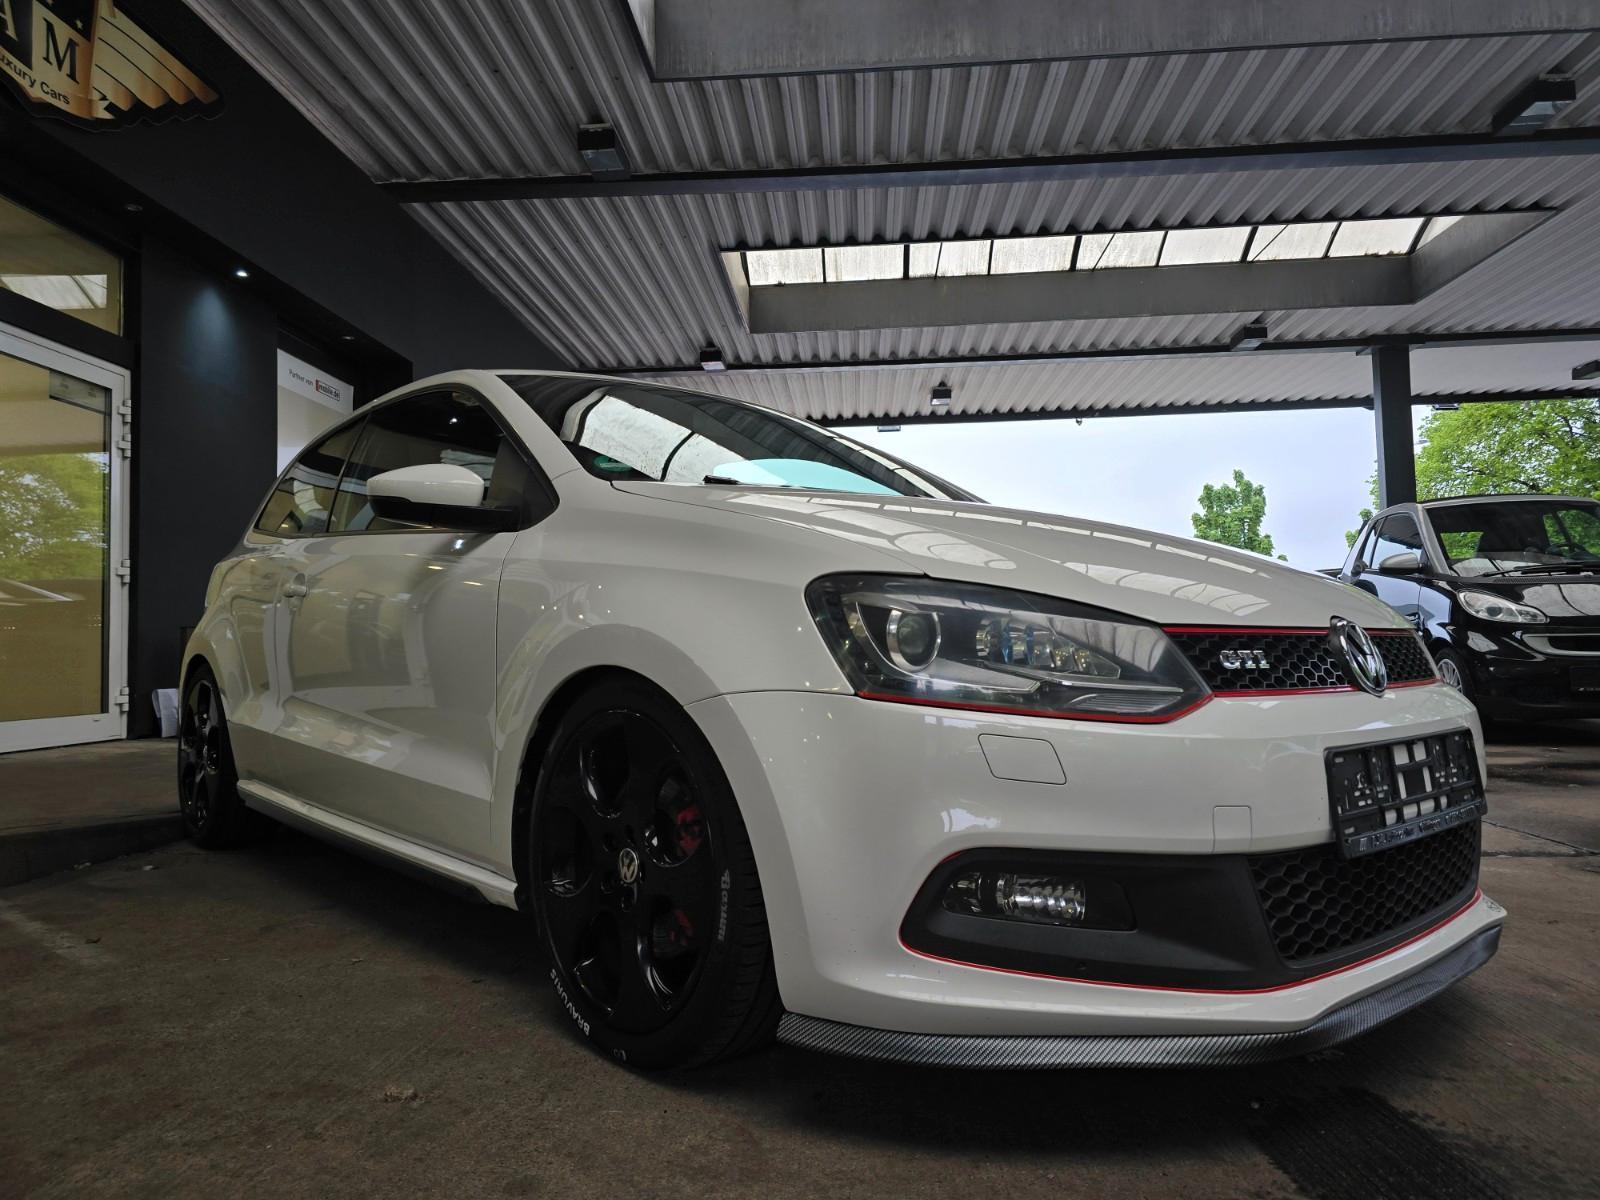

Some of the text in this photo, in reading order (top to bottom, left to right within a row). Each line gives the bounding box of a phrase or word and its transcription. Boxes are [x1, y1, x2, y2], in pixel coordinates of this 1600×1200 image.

[40, 81, 70, 105] Cars
[1219, 650, 1270, 669] GTI
[550, 968, 591, 1037] BRAVURIS
